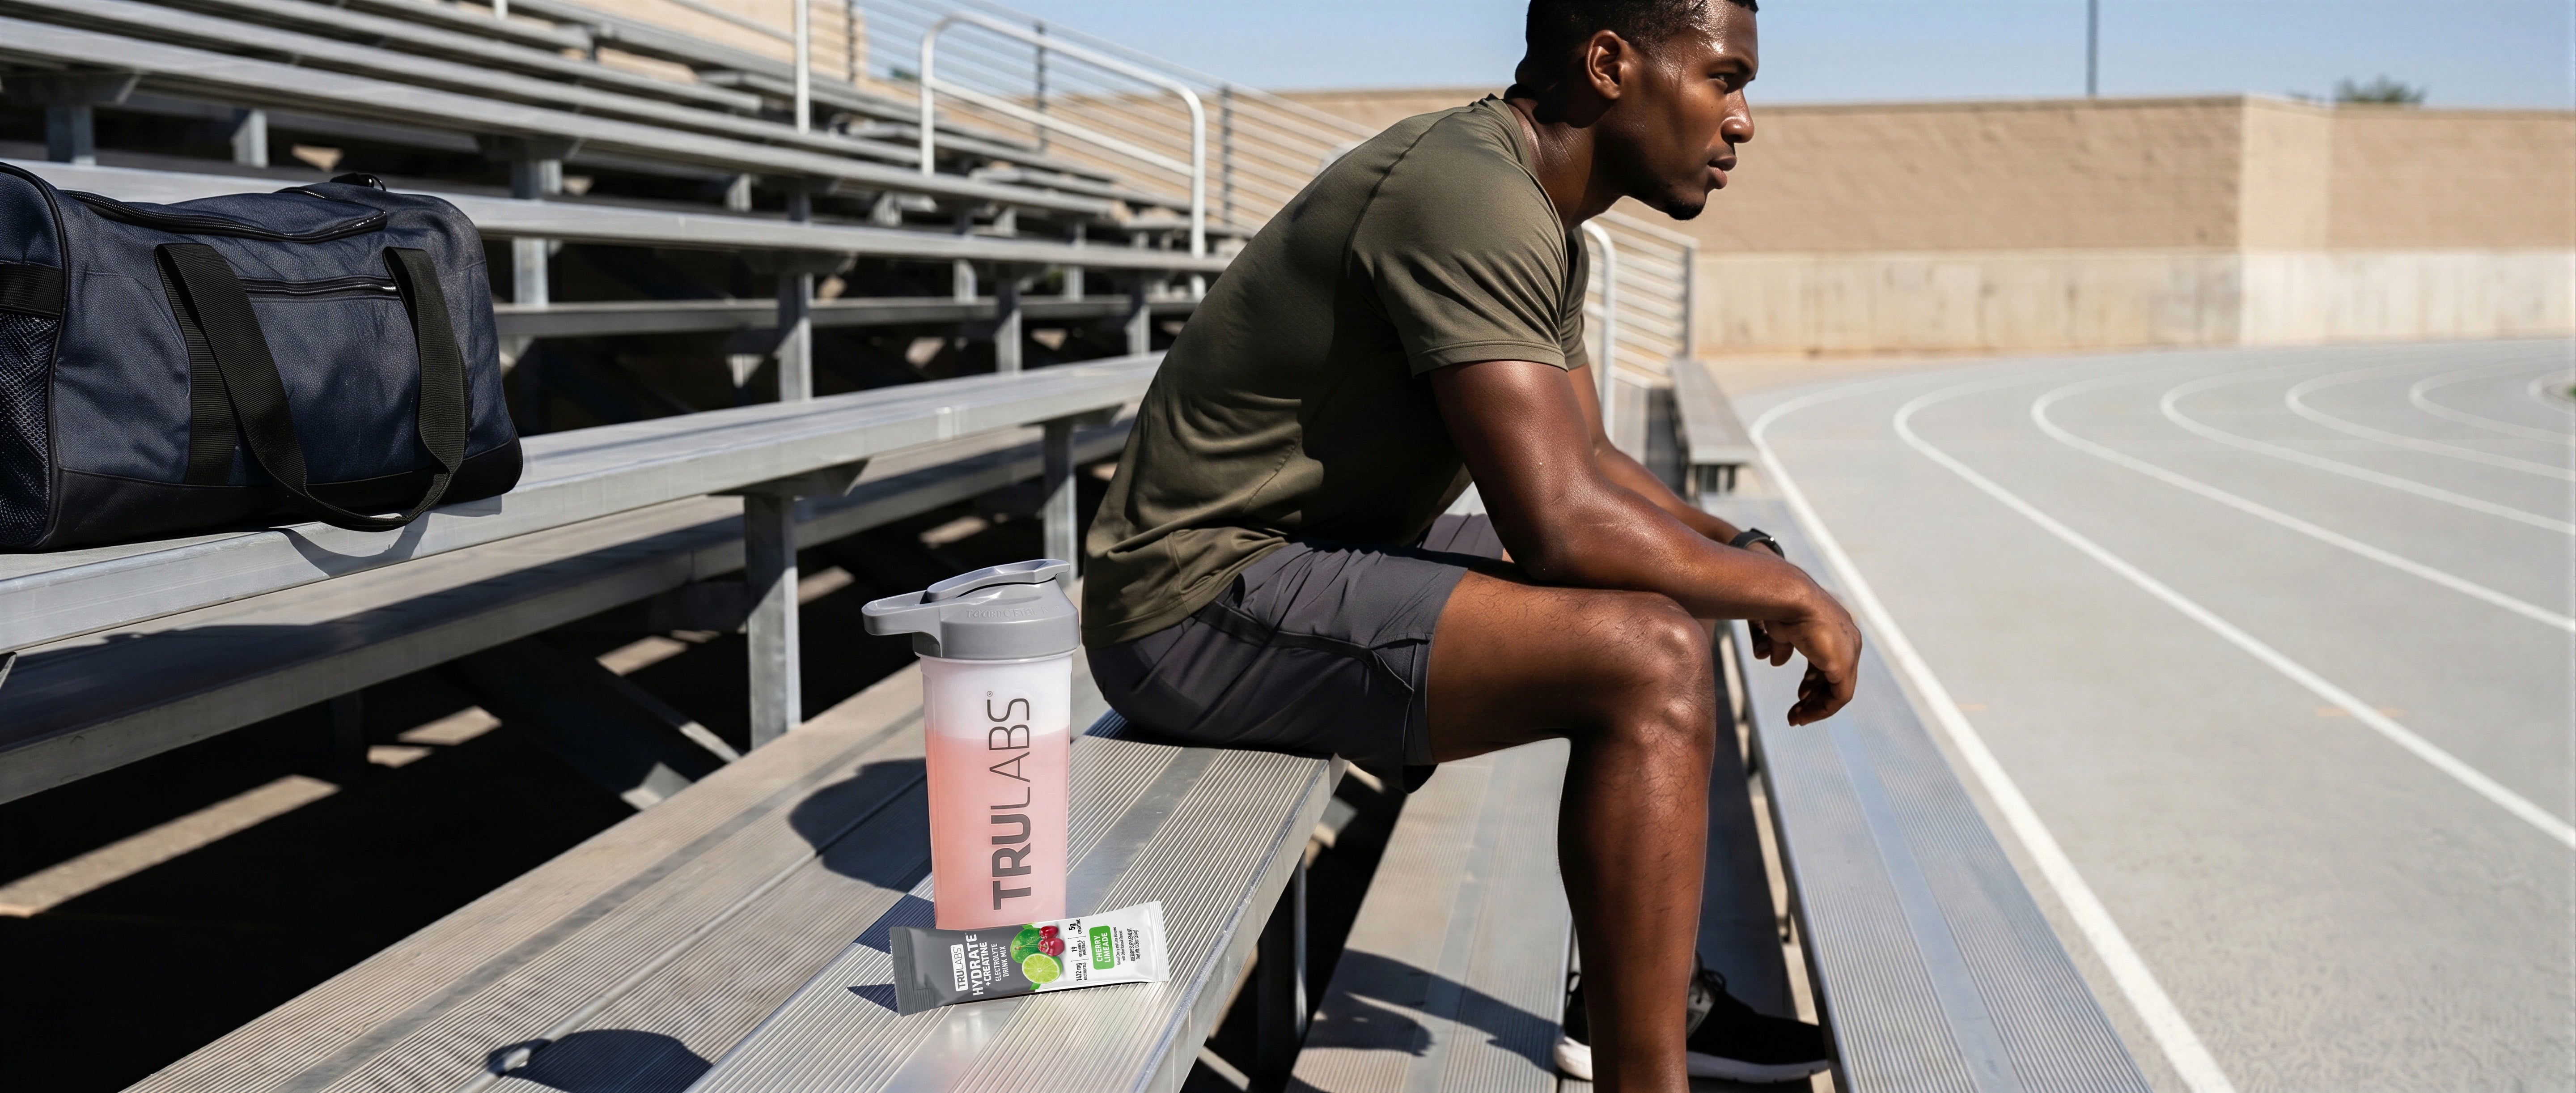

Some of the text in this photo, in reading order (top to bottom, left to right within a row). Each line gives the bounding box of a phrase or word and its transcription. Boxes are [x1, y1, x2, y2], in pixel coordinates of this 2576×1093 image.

[991, 944, 1001, 981] ELECTROLYTE
[1094, 936, 1103, 962] CHERRY
[1101, 932, 1111, 962] LIMEADE
[979, 942, 991, 986] +CREATINE
